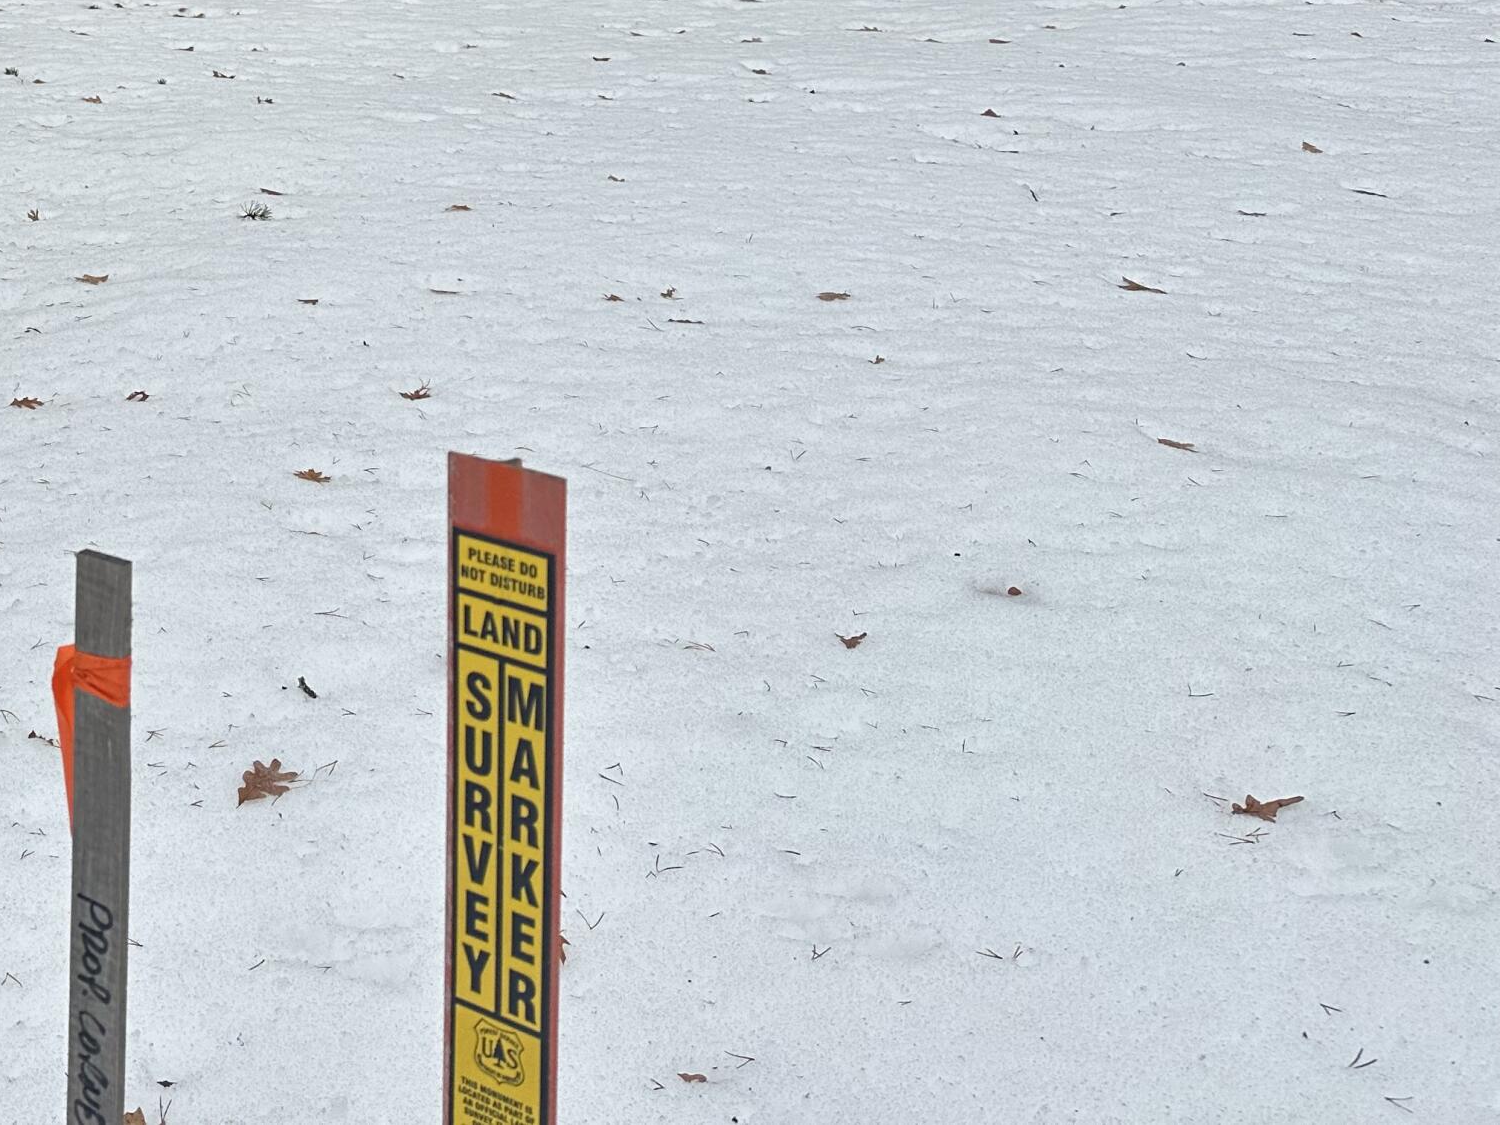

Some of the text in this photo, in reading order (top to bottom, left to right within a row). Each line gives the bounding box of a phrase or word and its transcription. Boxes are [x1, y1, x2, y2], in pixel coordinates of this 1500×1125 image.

[461, 564, 545, 600] NOT DISTURB
[468, 548, 538, 579] PLEASE DO
[464, 604, 543, 656] LAND
[463, 672, 492, 994] SURVEY
[508, 676, 544, 1024] MARKER
